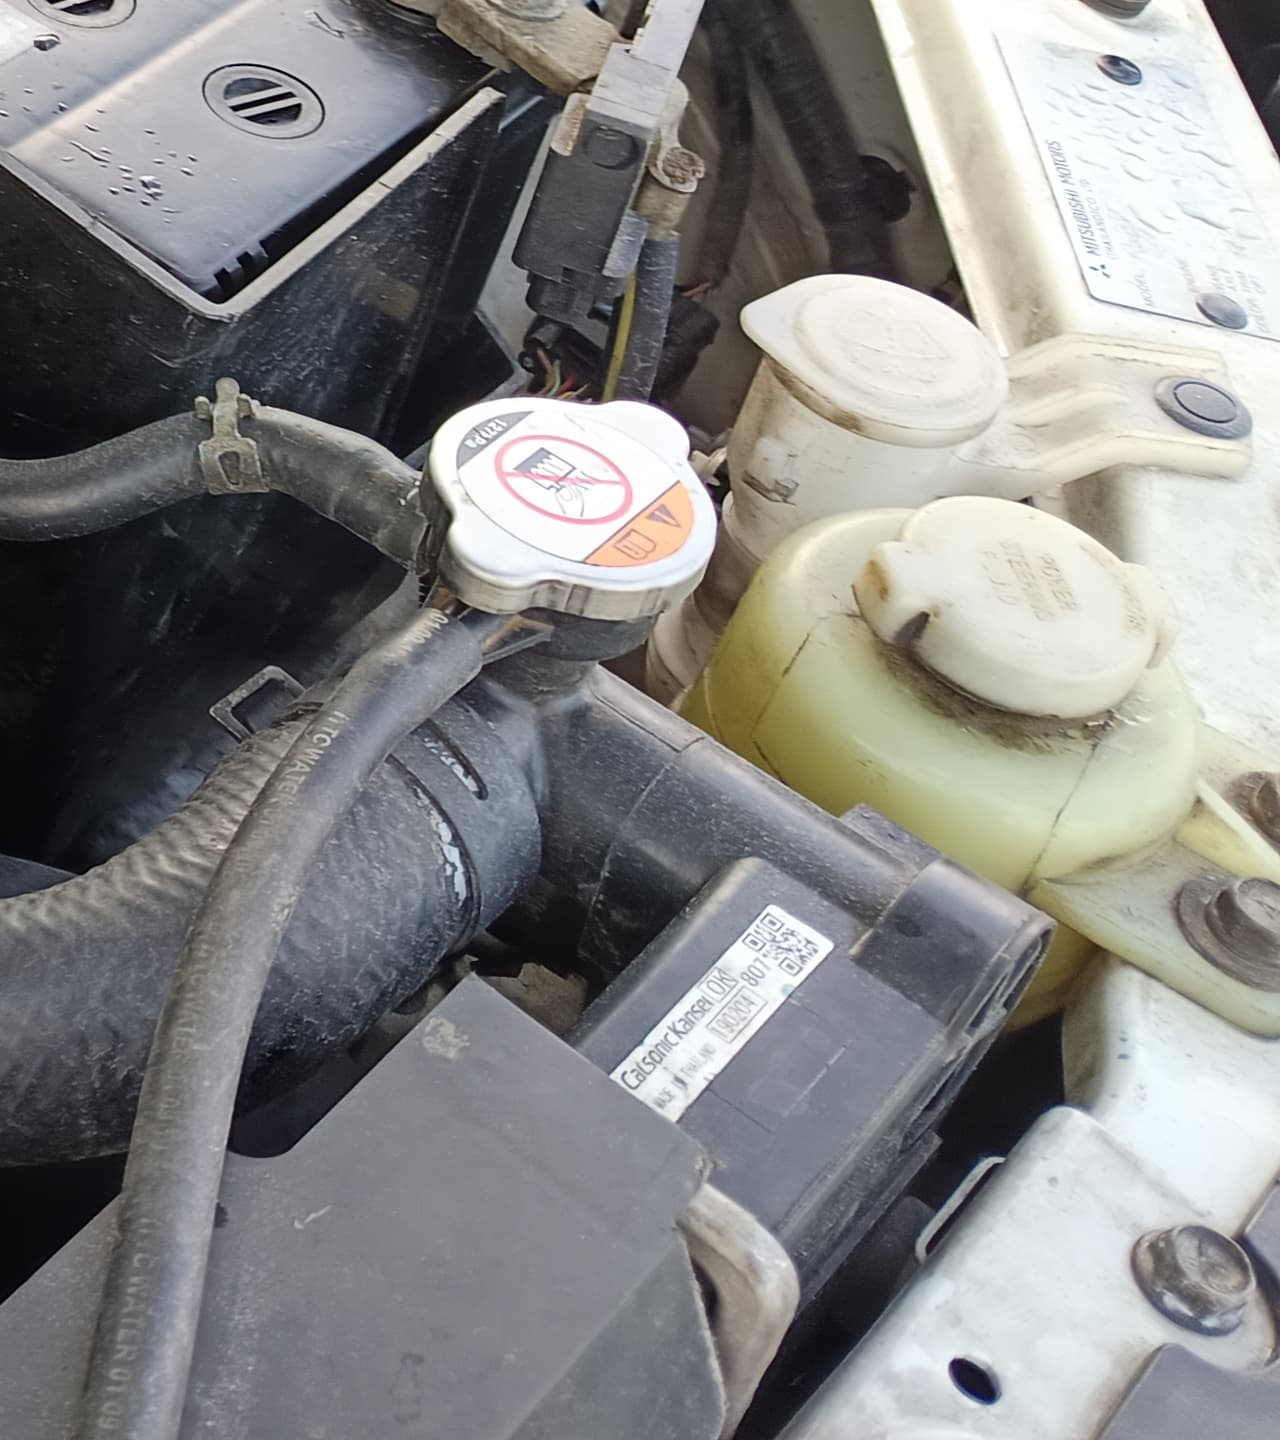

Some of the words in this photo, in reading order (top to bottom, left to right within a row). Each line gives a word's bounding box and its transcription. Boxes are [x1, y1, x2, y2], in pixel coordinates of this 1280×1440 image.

[1045, 139, 1071, 184] MOTORS
[1065, 189, 1100, 256] MITSUBISHI
[1039, 554, 1084, 612] POWER
[705, 969, 735, 999] OK
[740, 956, 771, 989] 807
[711, 993, 758, 1042] 190204
[113, 1275, 147, 1360] WATER
